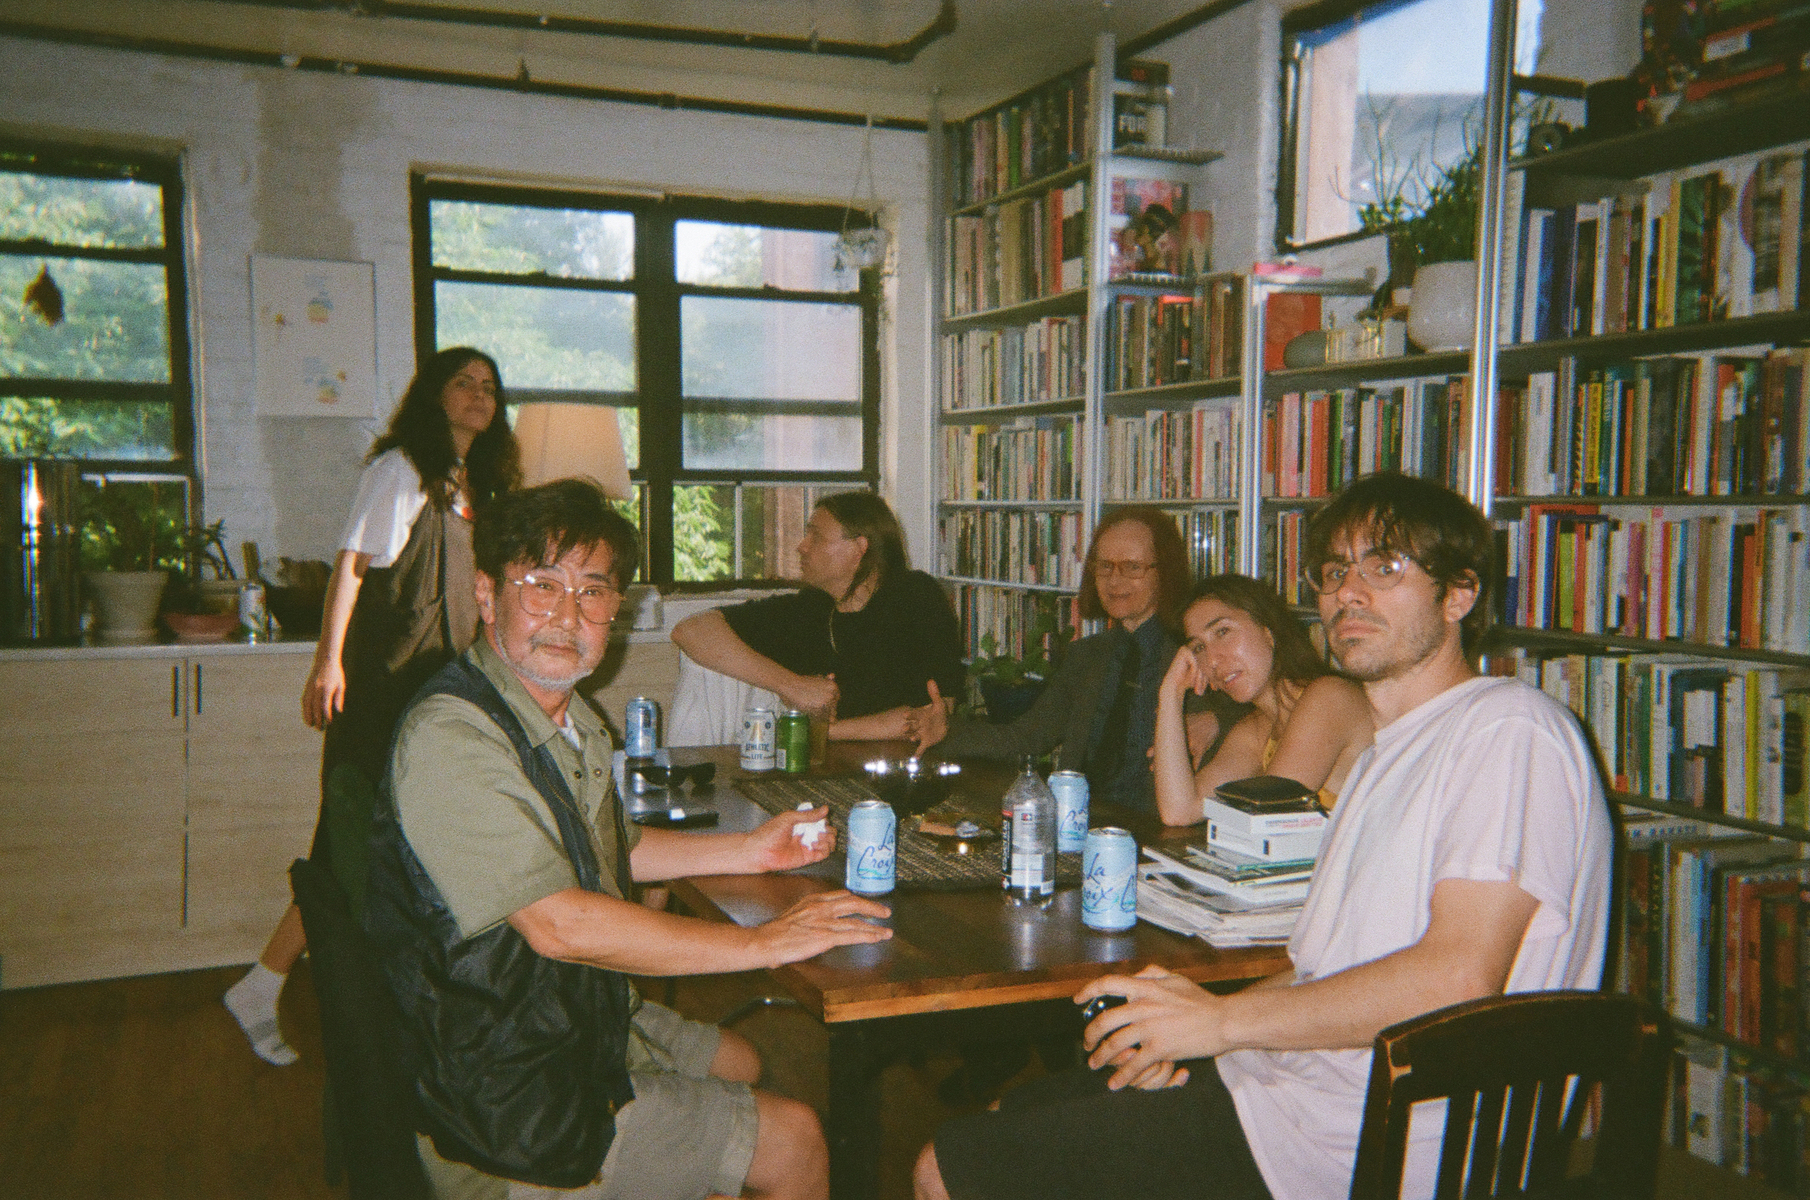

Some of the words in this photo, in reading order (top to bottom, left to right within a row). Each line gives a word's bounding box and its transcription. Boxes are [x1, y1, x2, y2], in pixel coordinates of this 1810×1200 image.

[745, 743, 770, 752] ATHLETIC
[877, 822, 895, 851] La
[1086, 852, 1106, 885] La
